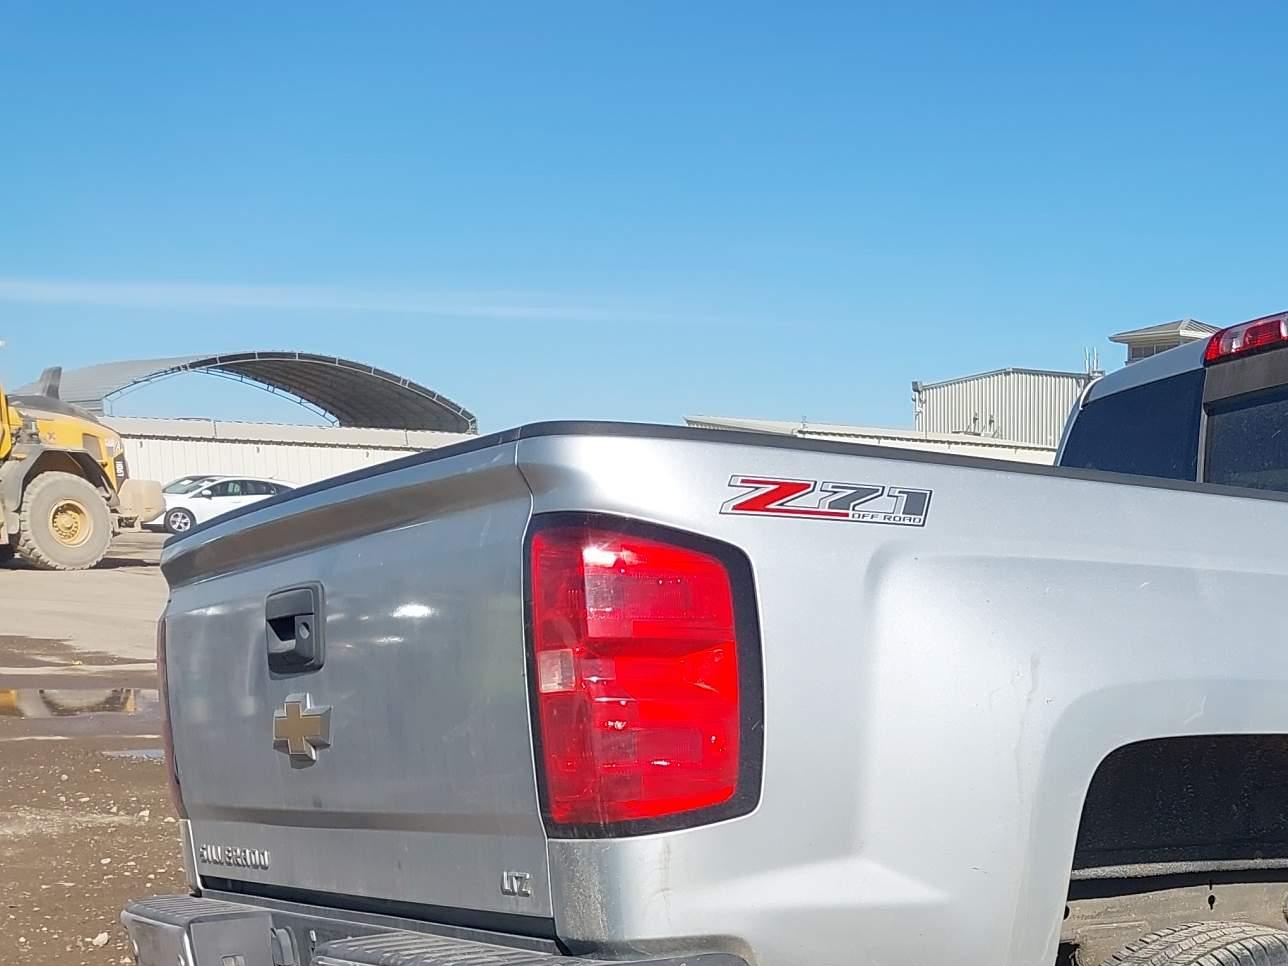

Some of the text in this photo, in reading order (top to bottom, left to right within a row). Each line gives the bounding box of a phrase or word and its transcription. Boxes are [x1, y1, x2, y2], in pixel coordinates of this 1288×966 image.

[719, 475, 933, 527] Z71
[851, 512, 922, 524] OFF ROAD
[200, 844, 269, 870] SILVERADO
[501, 871, 531, 897] LTZ
